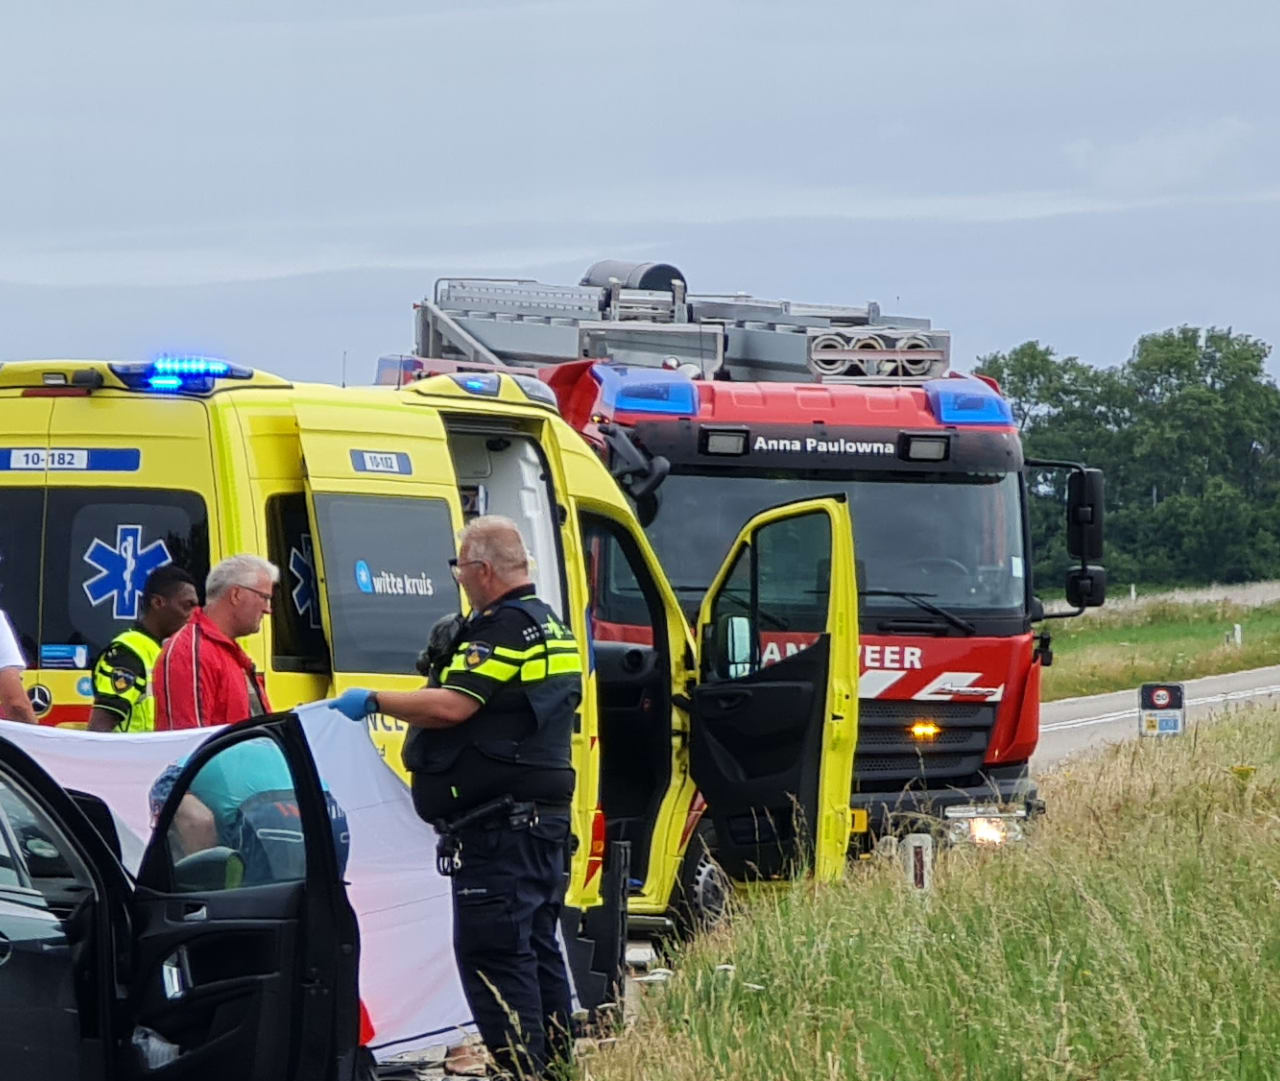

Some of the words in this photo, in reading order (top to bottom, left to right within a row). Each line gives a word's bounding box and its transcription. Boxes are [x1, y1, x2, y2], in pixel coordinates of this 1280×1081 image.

[754, 436, 801, 451] Anna
[806, 438, 895, 454] Paulowna
[23, 453, 75, 466] 10-182
[372, 570, 404, 595] witte
[404, 571, 433, 596] kruis
